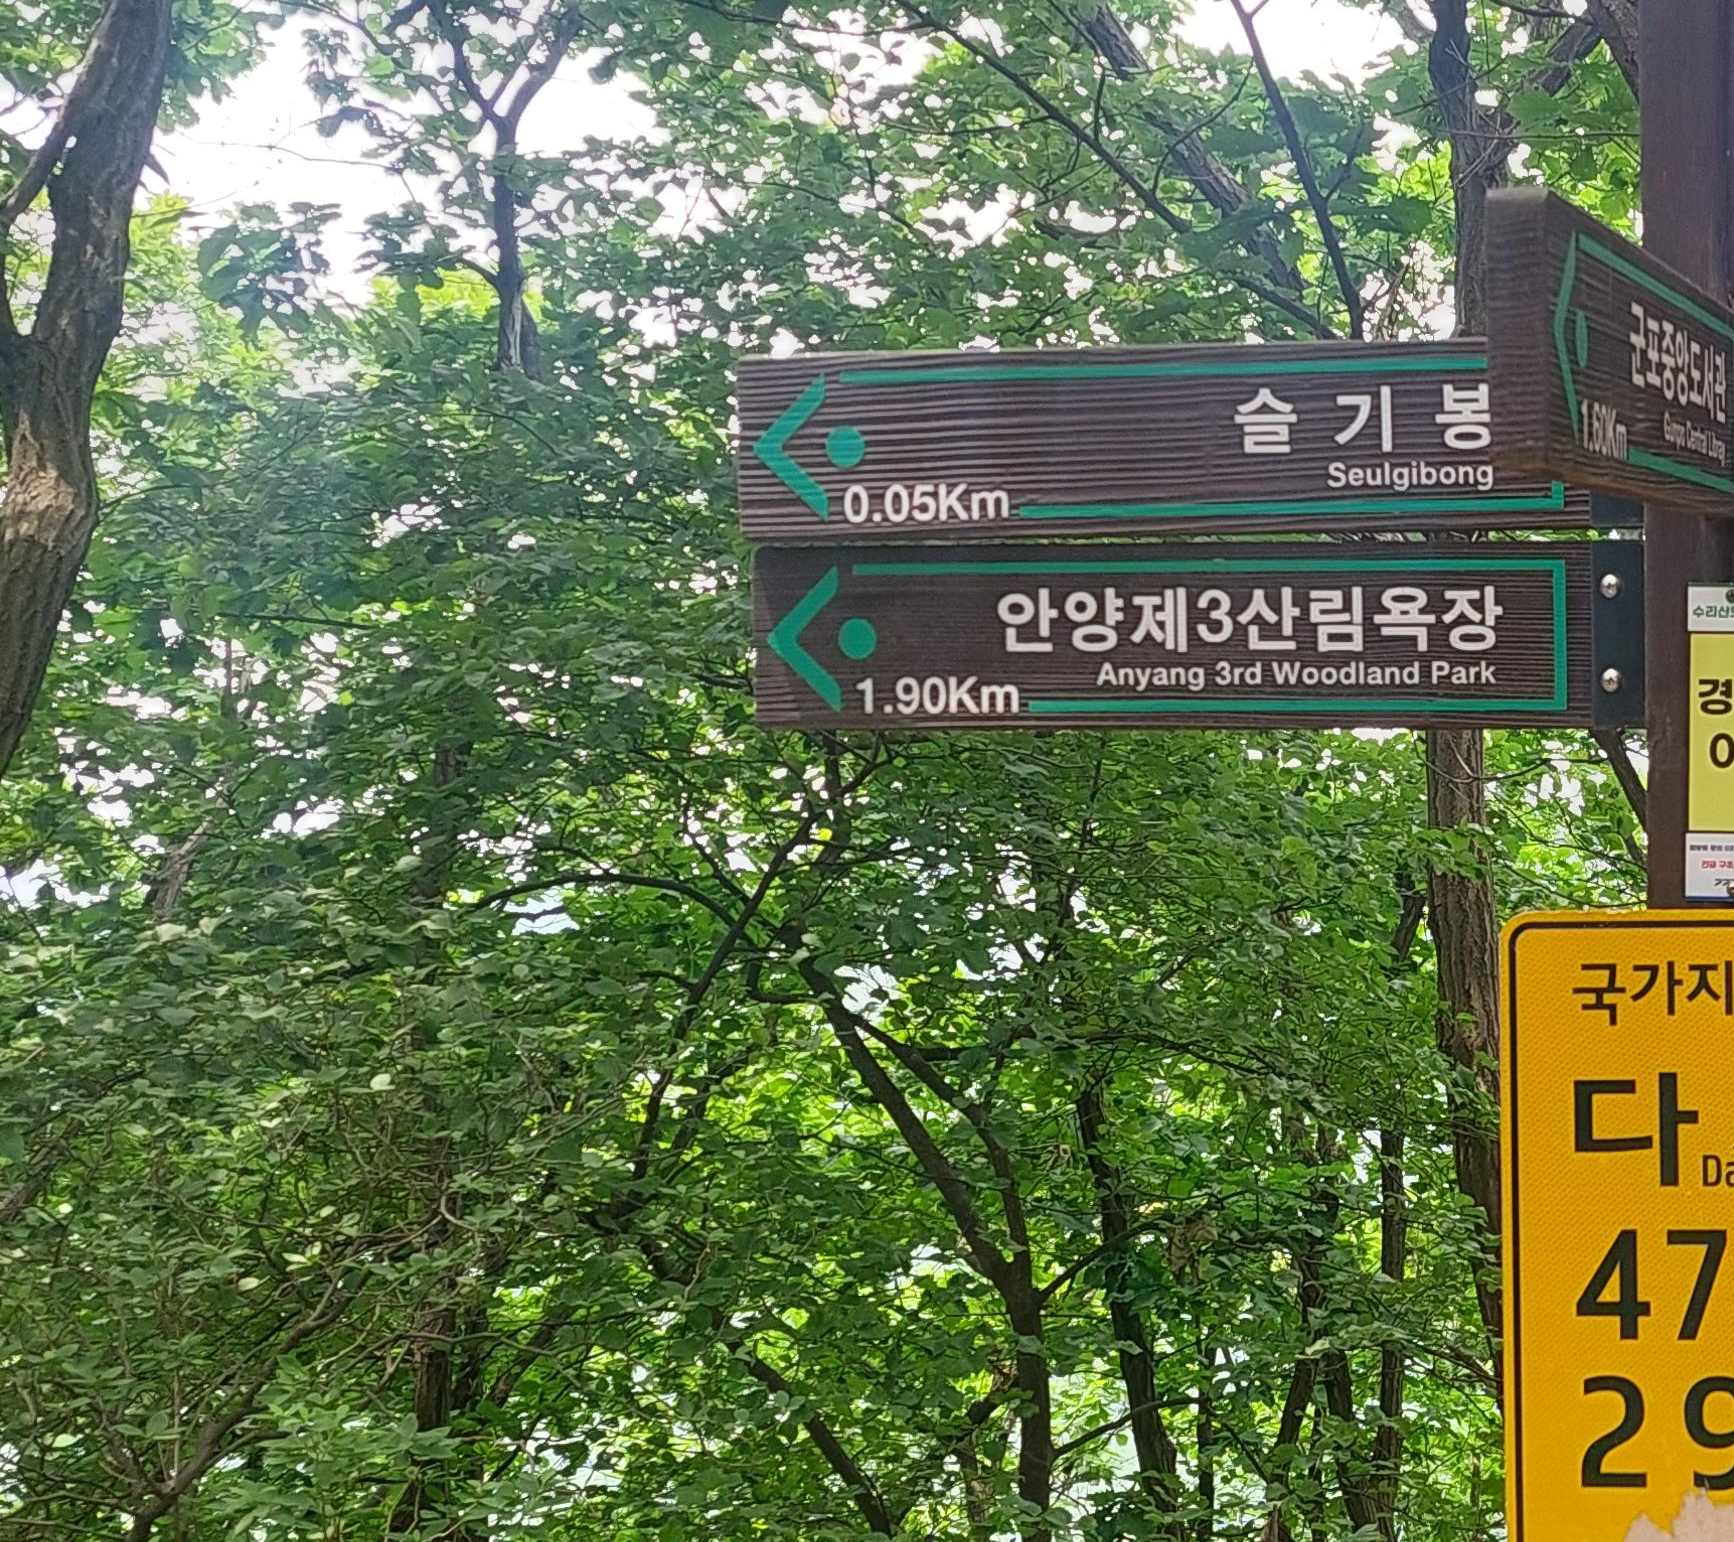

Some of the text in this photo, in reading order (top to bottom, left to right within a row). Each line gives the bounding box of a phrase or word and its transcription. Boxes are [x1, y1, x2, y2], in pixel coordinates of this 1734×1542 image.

[1630, 300, 1726, 424] 군포중앙도서관
[1327, 461, 1494, 492] Seulgibong
[843, 484, 1010, 524] 0.05Km
[998, 585, 1502, 653] 안양제3산림욕장
[856, 676, 1020, 715] 1.90Km
[1097, 661, 1496, 691] Anyang 3rd Woodland Park
